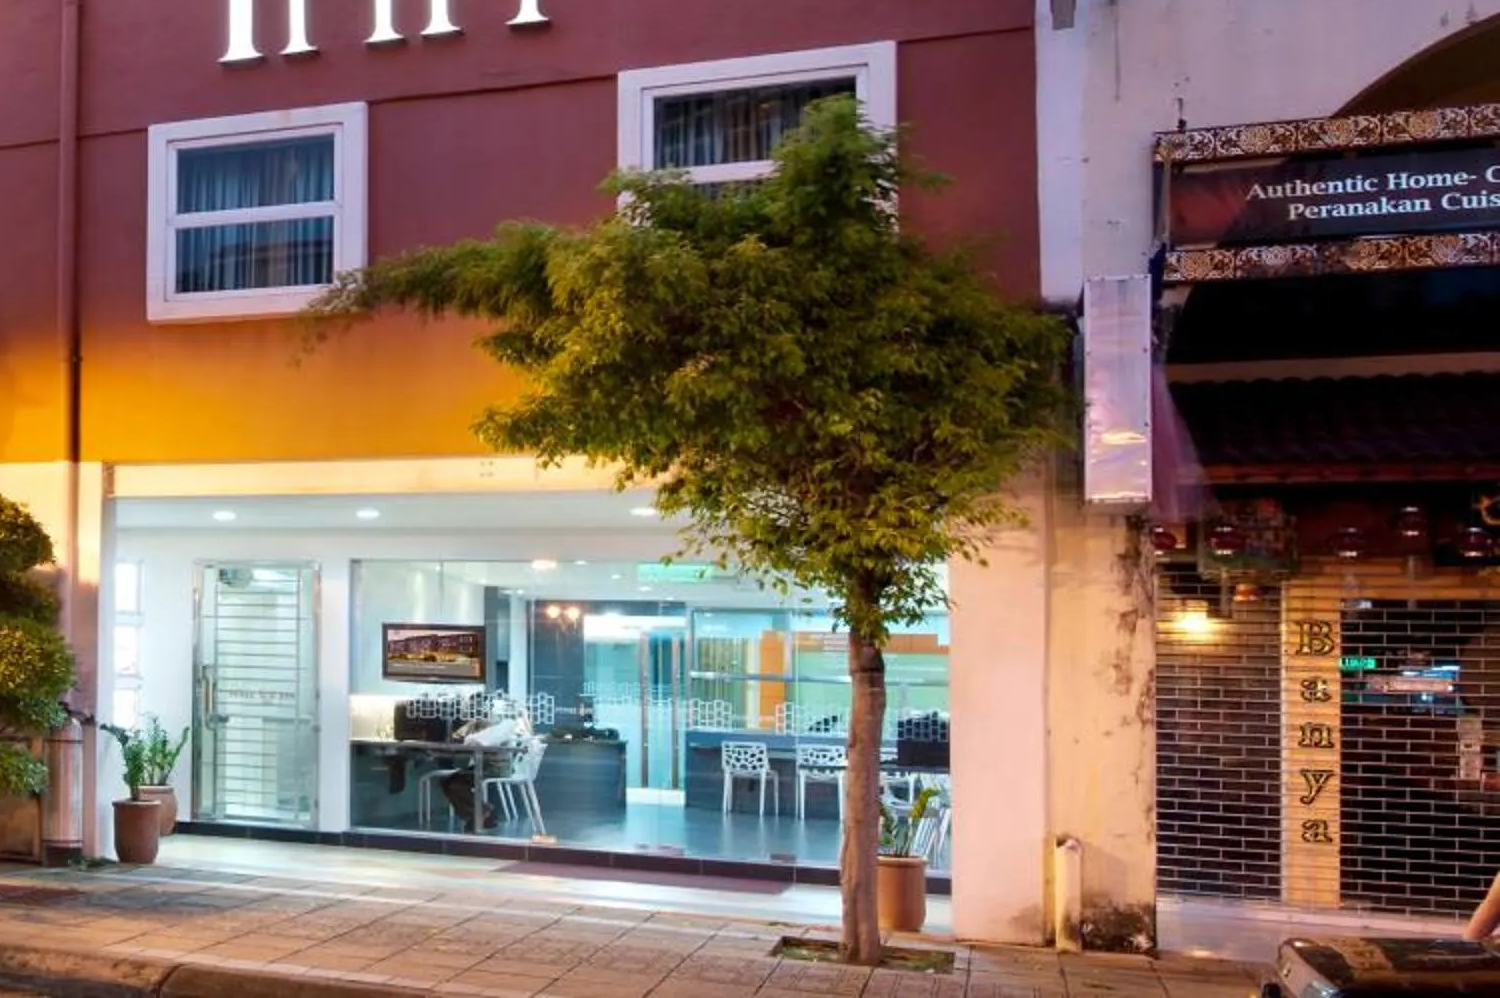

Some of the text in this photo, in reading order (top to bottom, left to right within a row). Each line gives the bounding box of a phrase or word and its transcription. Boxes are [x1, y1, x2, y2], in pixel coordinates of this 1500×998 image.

[1246, 174, 1378, 200] Authentic
[1288, 196, 1431, 221] Peranakan
[1296, 620, 1334, 844] Banya
